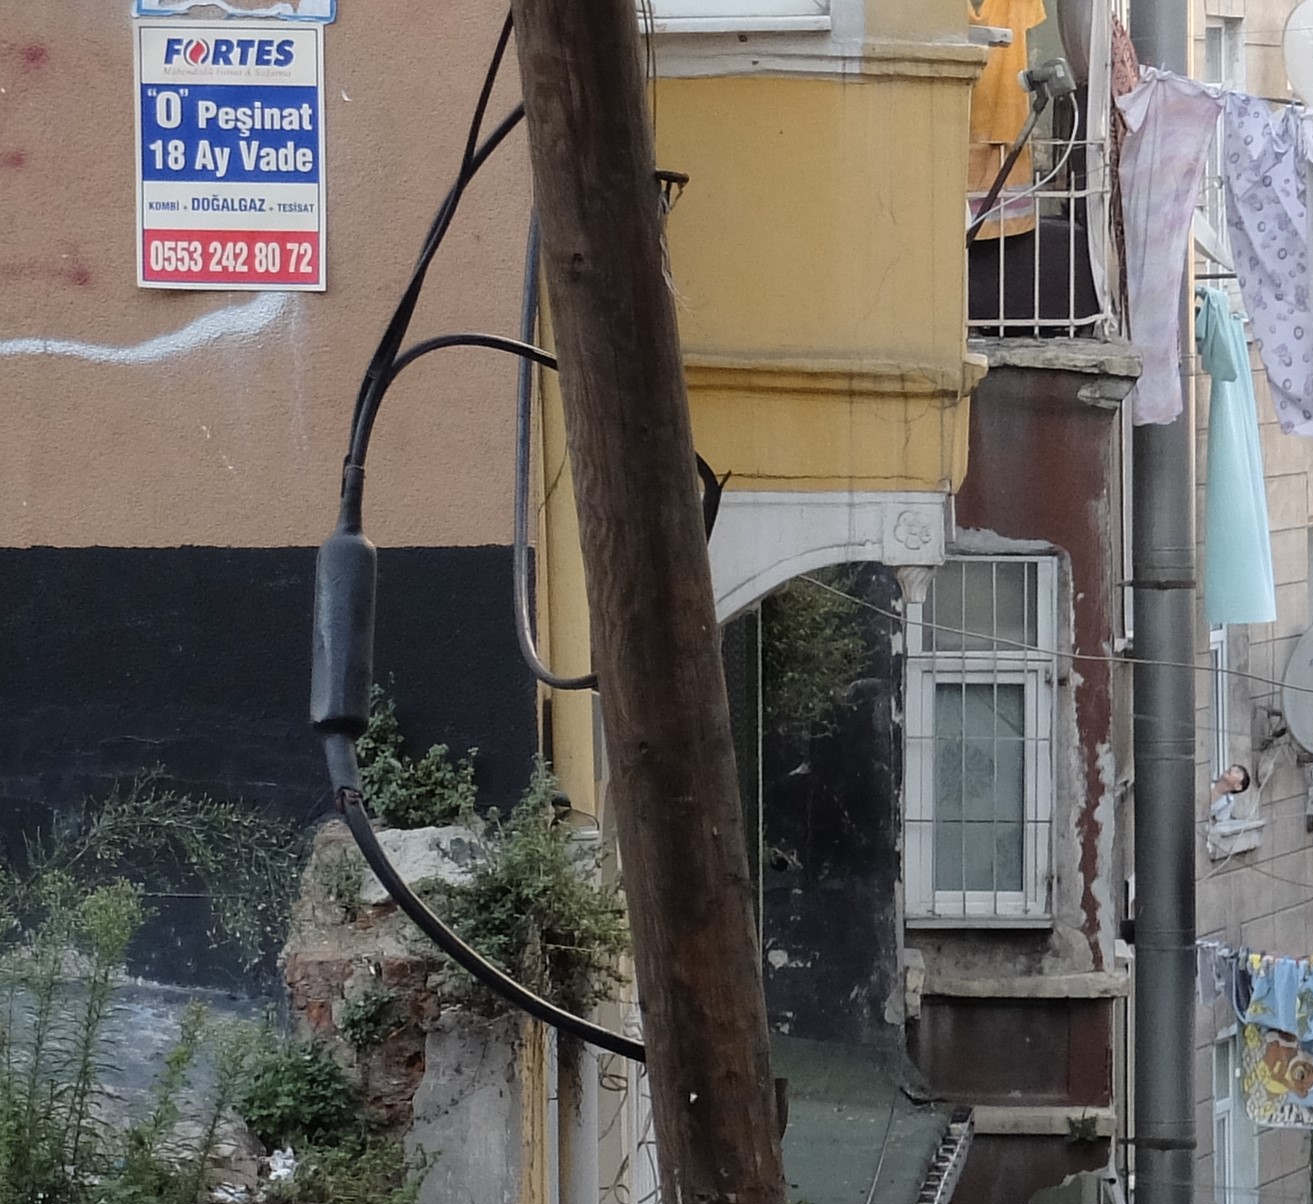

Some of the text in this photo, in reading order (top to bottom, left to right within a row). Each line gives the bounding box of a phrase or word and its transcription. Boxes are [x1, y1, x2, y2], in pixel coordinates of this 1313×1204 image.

[164, 38, 295, 67] FORTES
[198, 100, 313, 137] Peşinat
[149, 139, 314, 178] 18 Ay Vade
[149, 200, 180, 212] KOMBİ
[191, 194, 266, 213] DOĞALGAZ
[277, 202, 315, 213] TESİSAT
[150, 240, 313, 273] 0553 242 80 72
